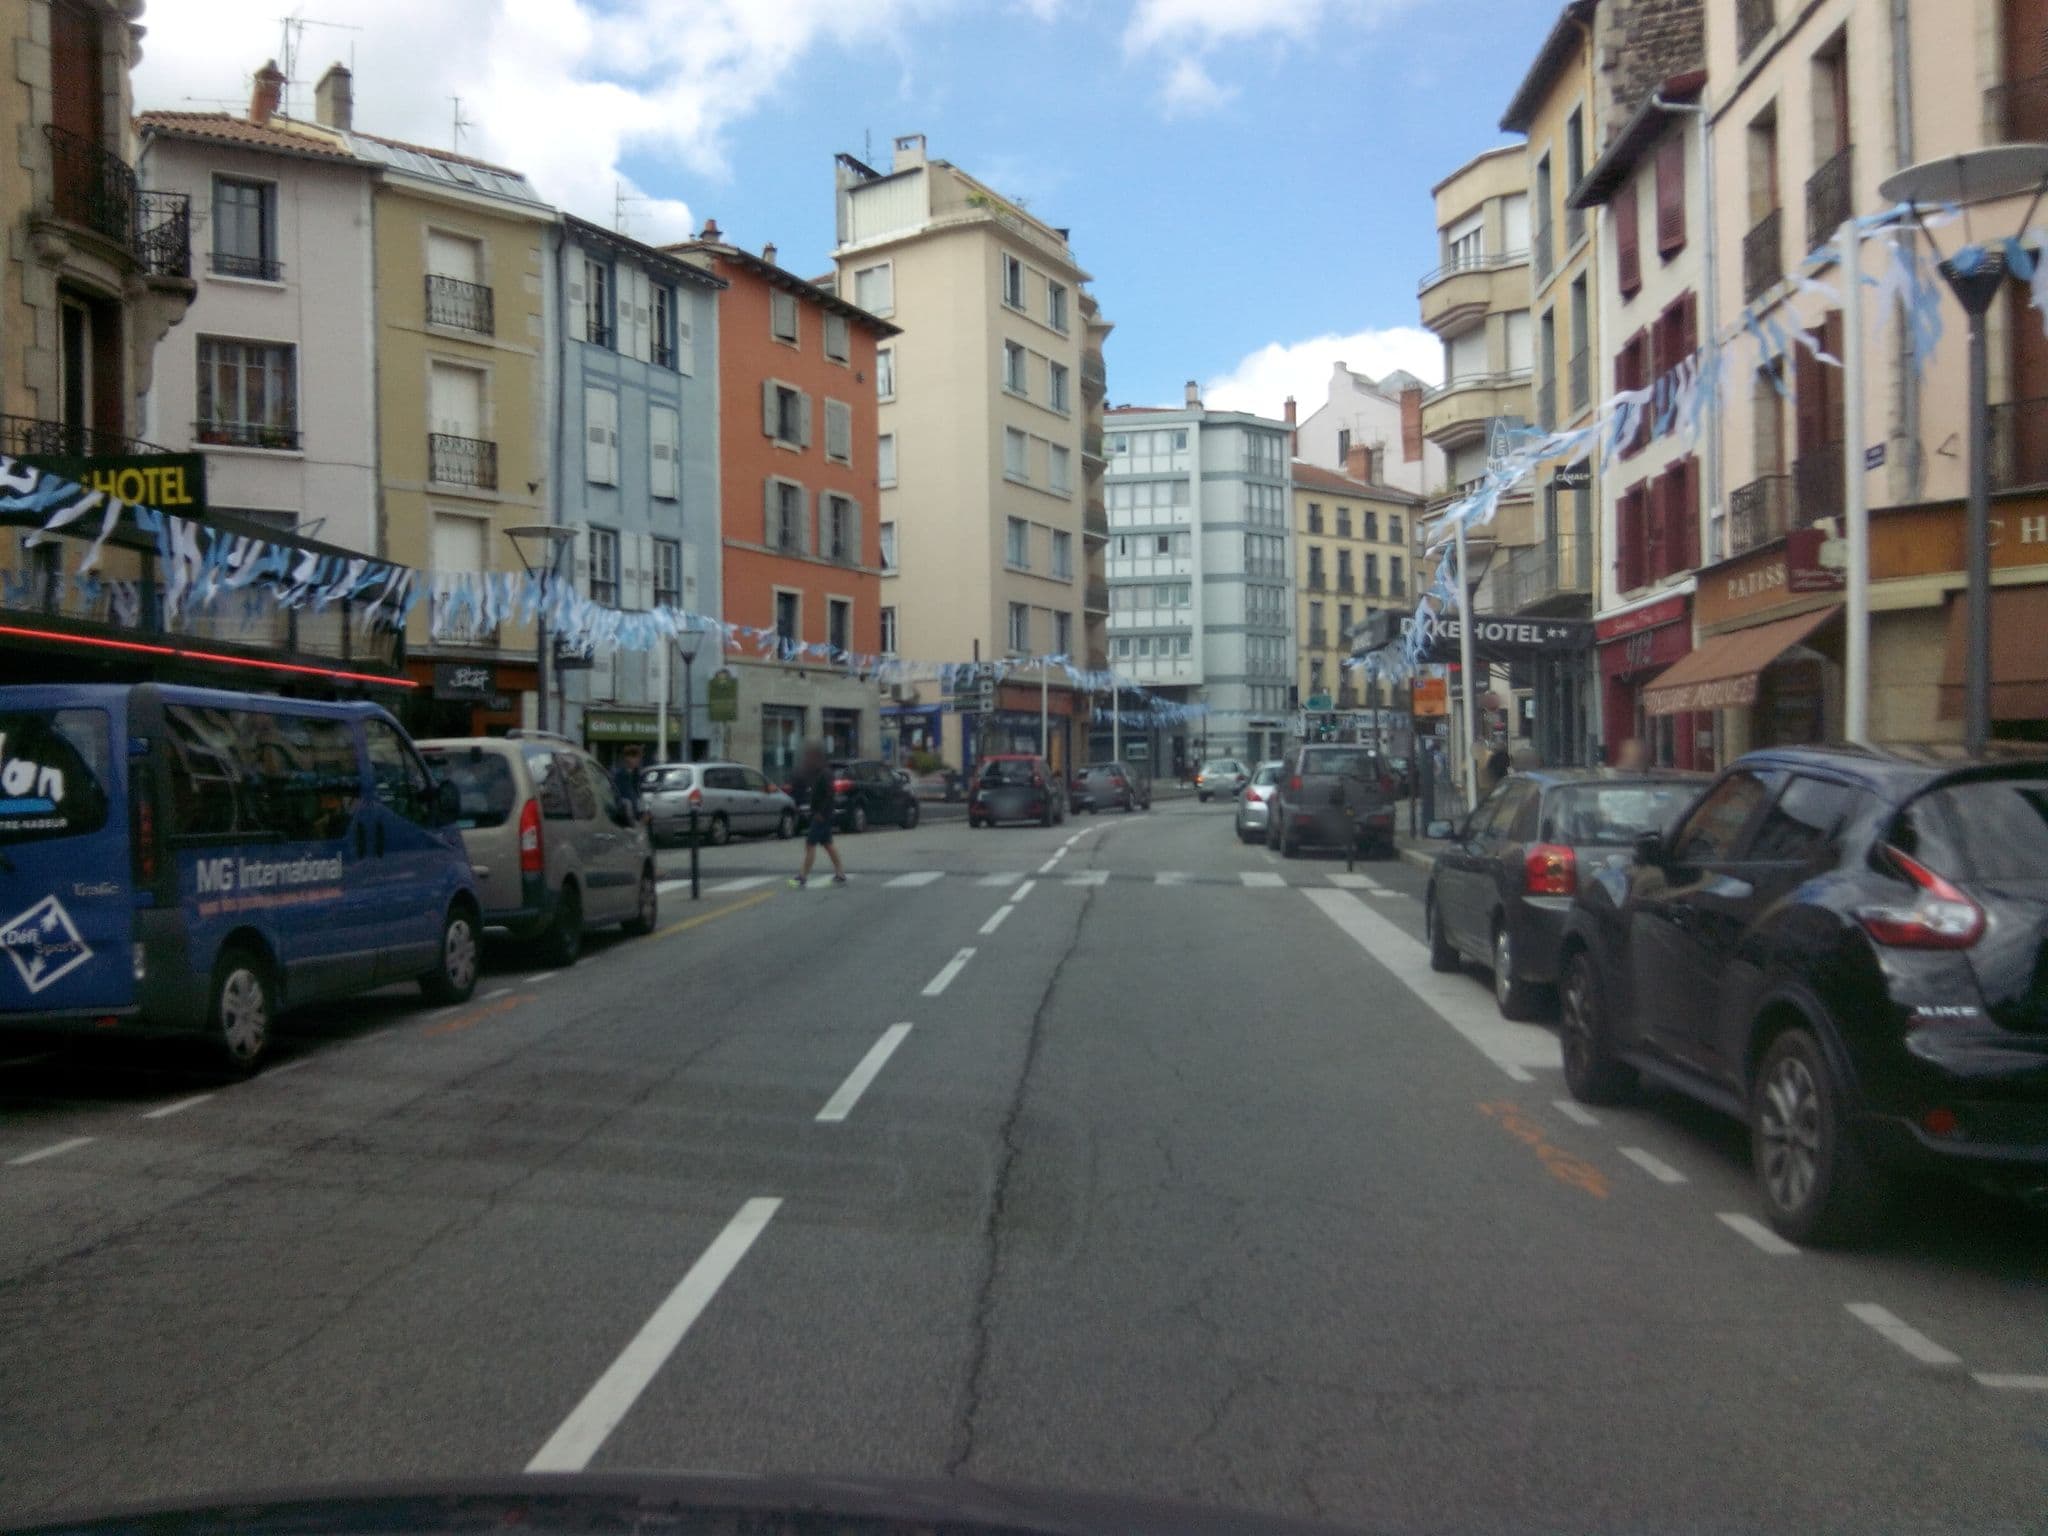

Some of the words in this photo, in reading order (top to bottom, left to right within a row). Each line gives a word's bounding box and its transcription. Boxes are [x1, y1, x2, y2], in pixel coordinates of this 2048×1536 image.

[93, 466, 192, 507] HOTEL
[1473, 623, 1543, 643] HOTEL
[197, 858, 234, 893] MG
[239, 851, 342, 889] International
